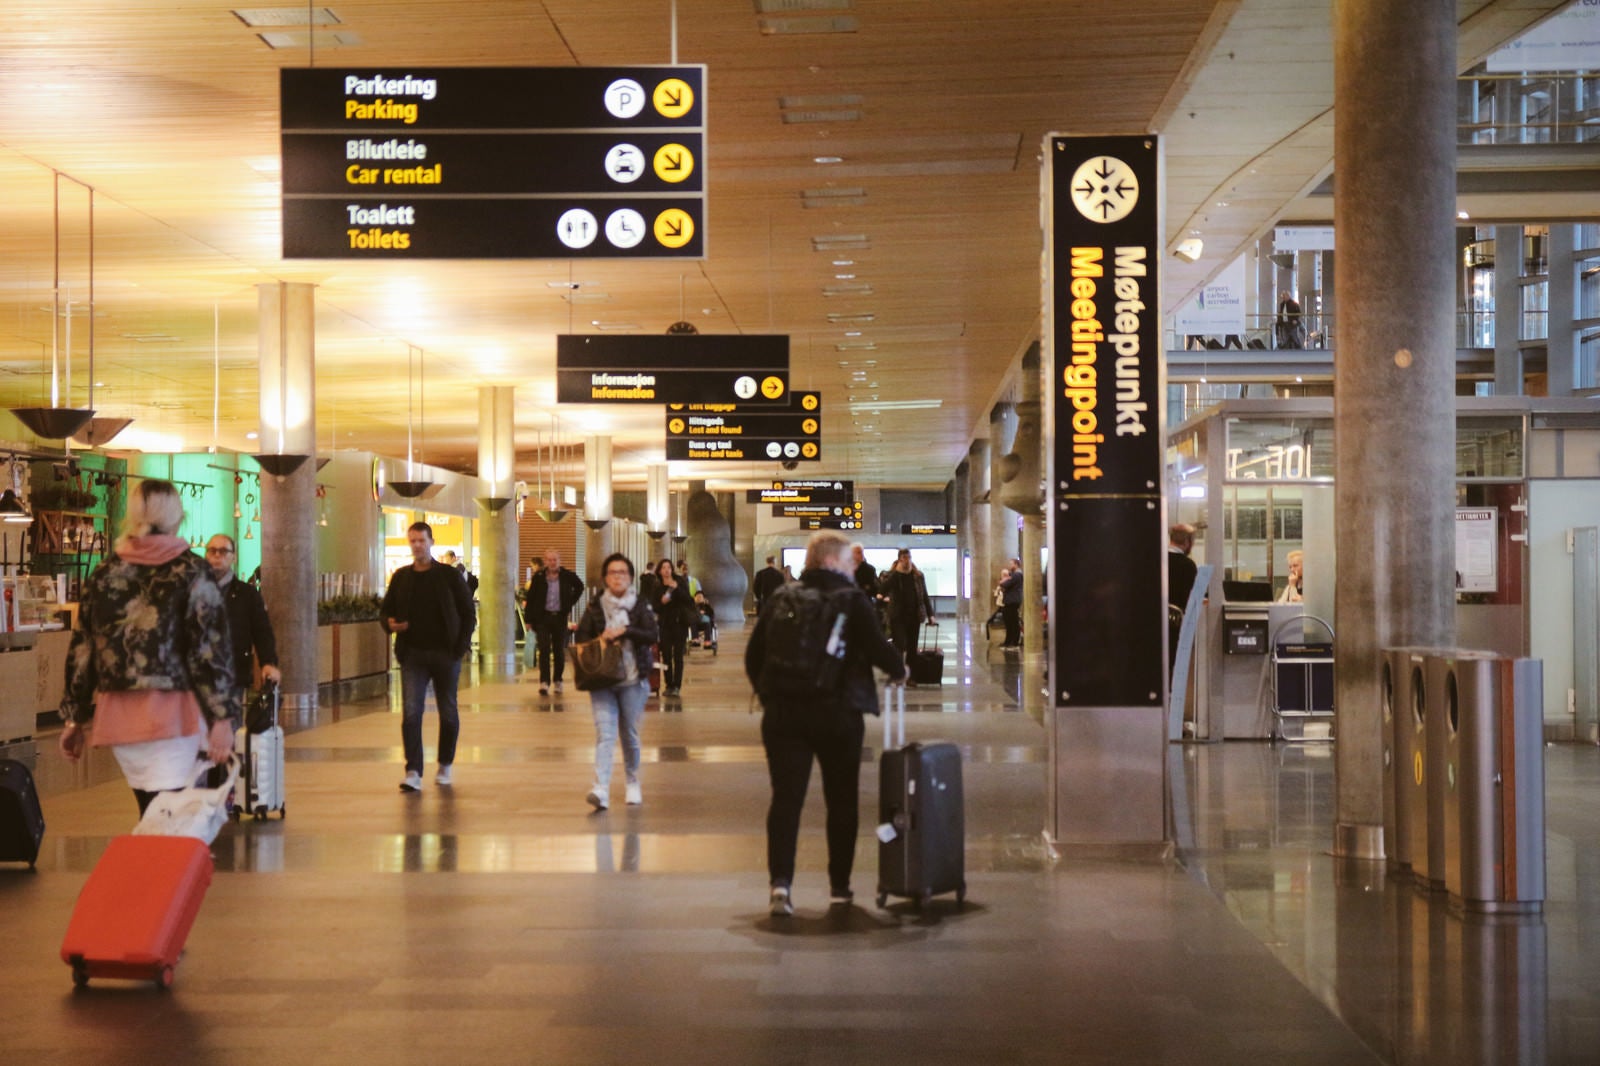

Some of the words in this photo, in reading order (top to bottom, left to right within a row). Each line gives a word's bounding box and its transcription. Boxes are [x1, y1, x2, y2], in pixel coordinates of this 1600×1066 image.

[345, 75, 437, 101] Parkering
[345, 99, 418, 125] Parking
[346, 140, 427, 160] Bilutleie
[346, 165, 379, 185] Car
[383, 164, 442, 185] rental
[346, 204, 415, 225] Toalett
[347, 228, 410, 249] Toilets
[1108, 246, 1148, 437] Møtepunkt
[1064, 246, 1105, 481] Meetingpoint
[591, 373, 656, 388] Informasjon
[591, 386, 655, 399] Information
[689, 425, 705, 434] Lost
[706, 425, 719, 434] and
[720, 425, 743, 434] found
